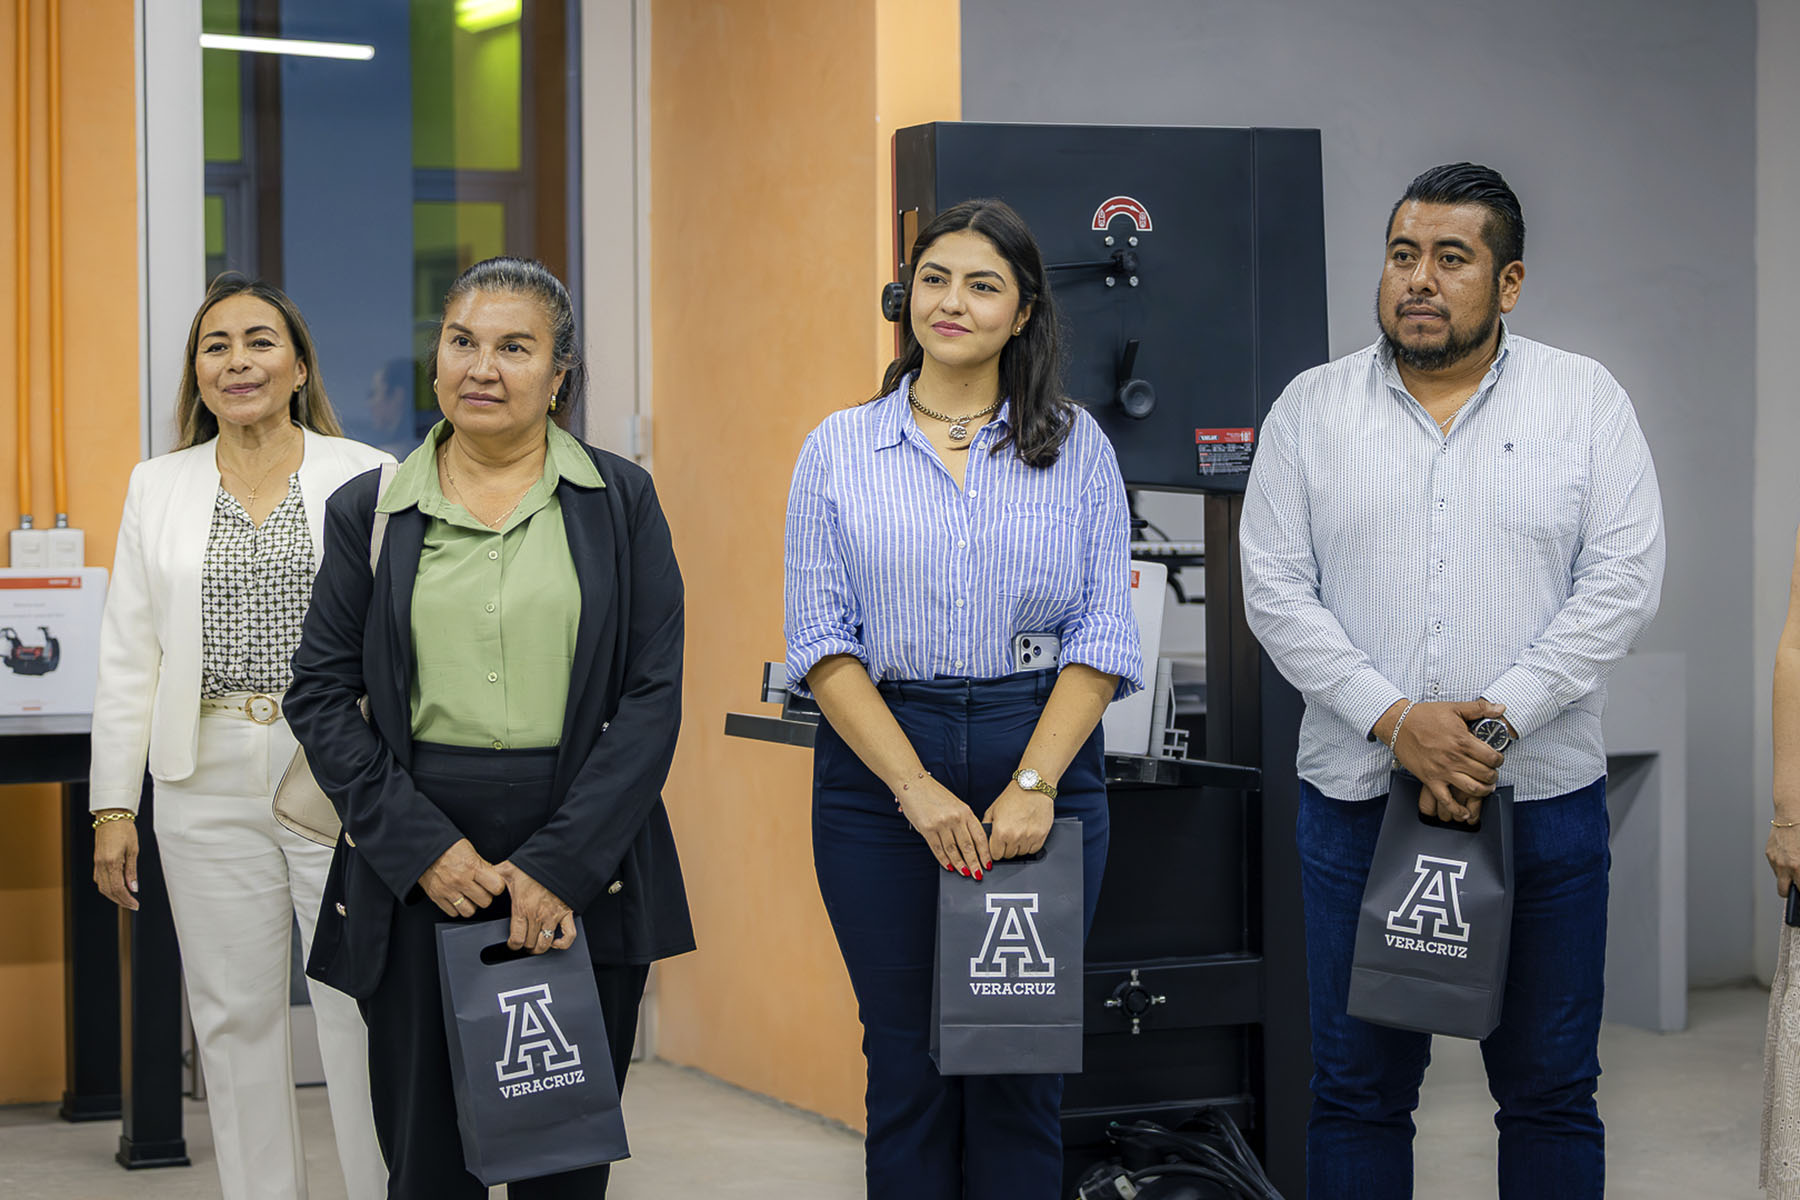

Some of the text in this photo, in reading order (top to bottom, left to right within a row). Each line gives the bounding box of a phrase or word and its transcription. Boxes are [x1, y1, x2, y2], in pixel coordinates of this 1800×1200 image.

[1386, 854, 1470, 942] A
[970, 893, 1055, 977] A
[1385, 934, 1468, 958] VERACRUZ
[970, 982, 1056, 995] VERACRUZ
[496, 983, 581, 1082] A
[500, 1070, 585, 1099] VERACRUZ
